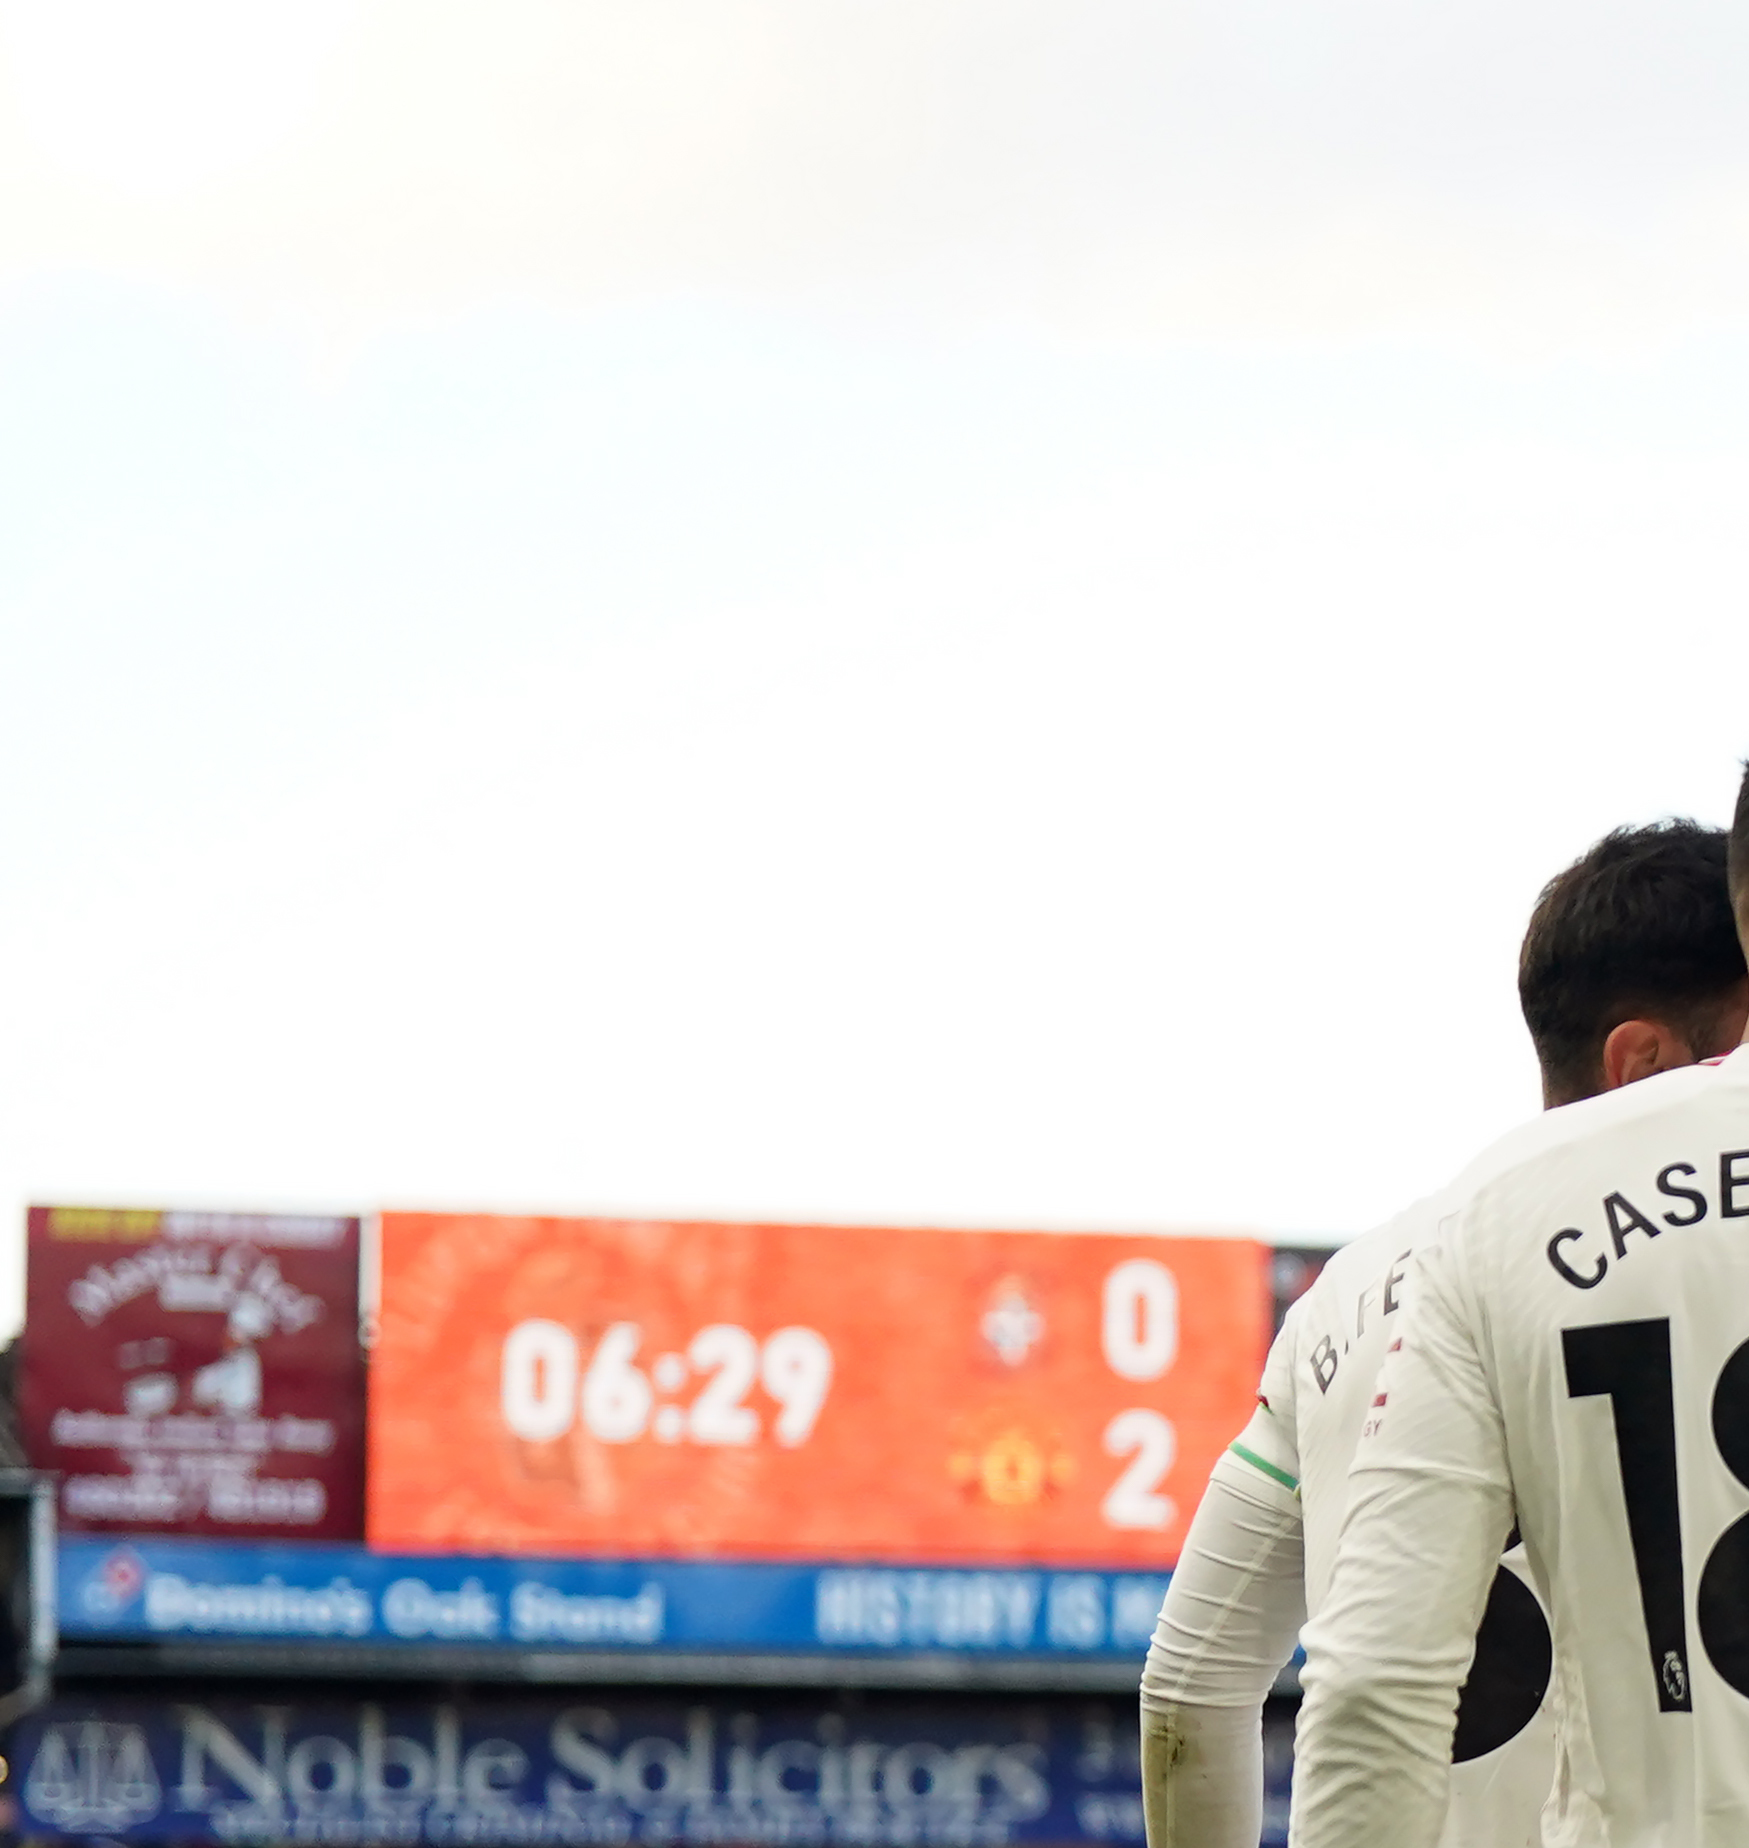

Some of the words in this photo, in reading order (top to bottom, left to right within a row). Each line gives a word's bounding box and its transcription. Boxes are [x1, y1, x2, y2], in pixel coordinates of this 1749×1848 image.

[1102, 1257, 1178, 1382] 0
[502, 1316, 832, 1448] 06:29
[1102, 1407, 1177, 1529] 2
[172, 1702, 532, 1812] Noble
[546, 1704, 1051, 1822] Solicitors
